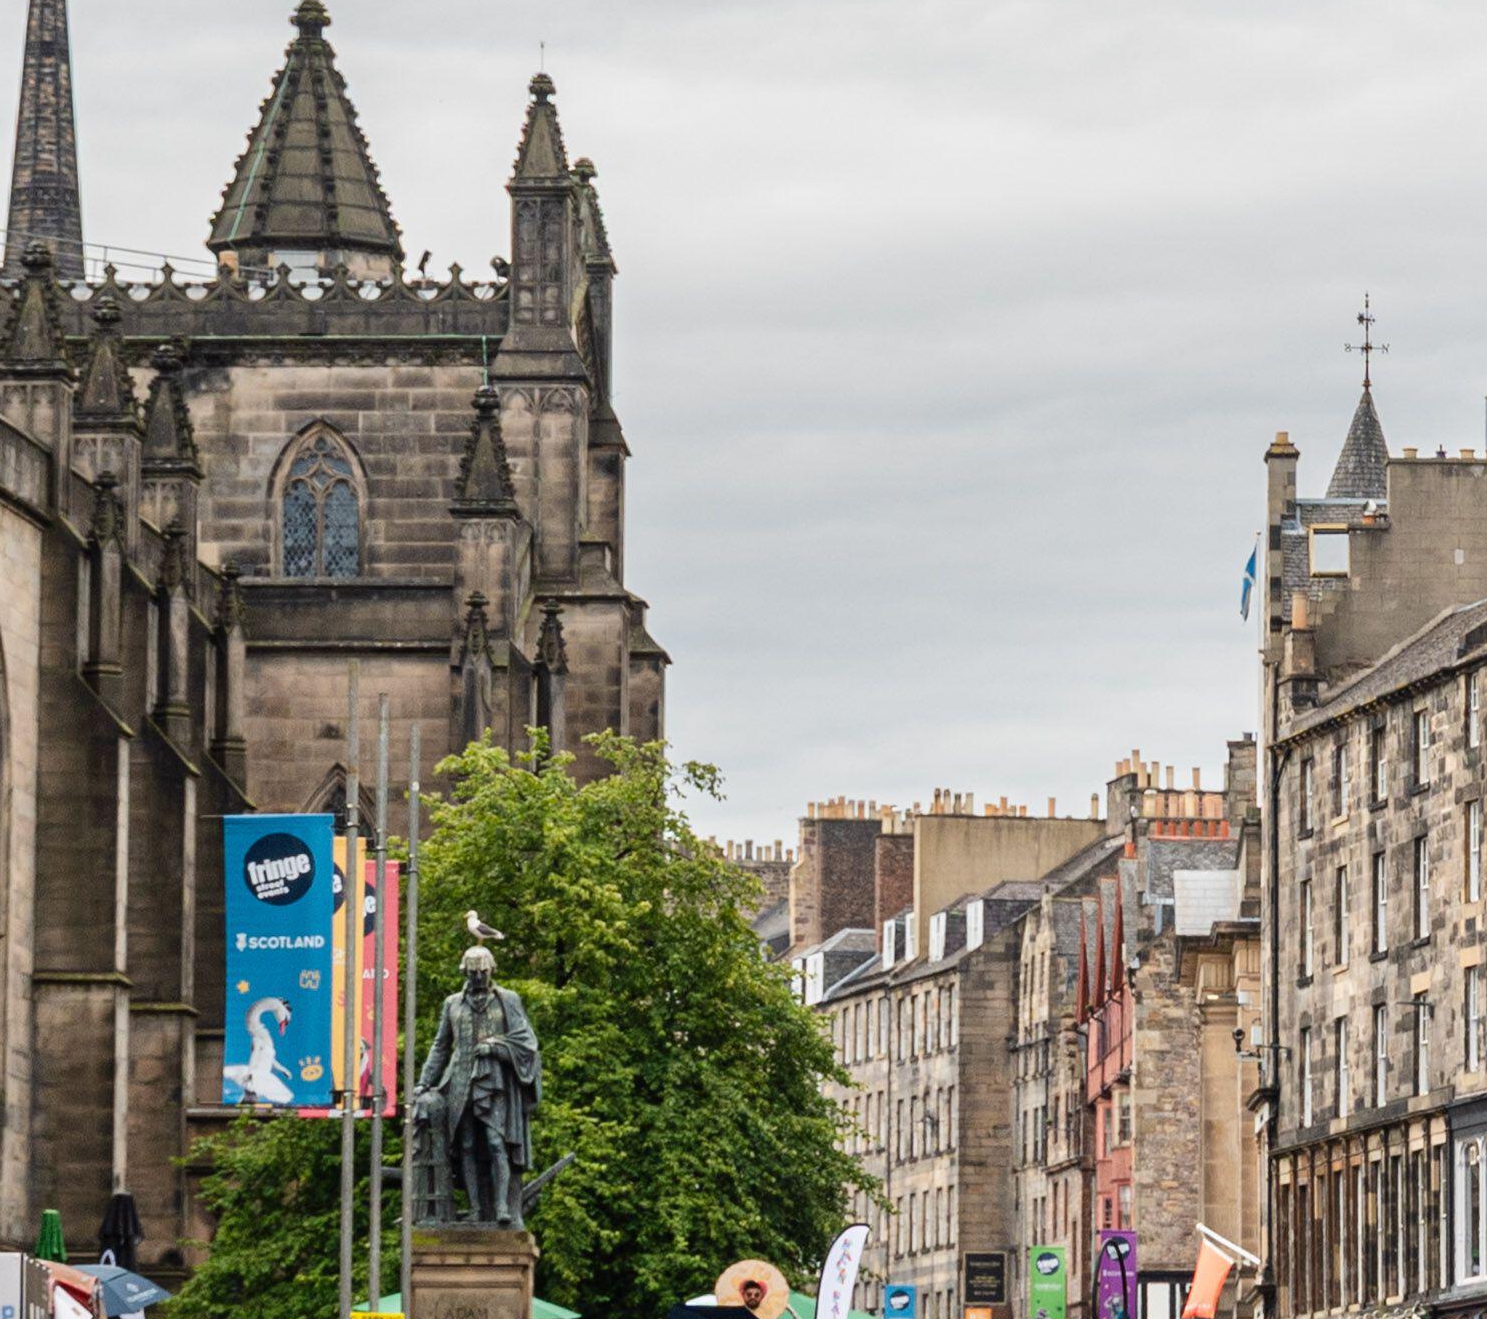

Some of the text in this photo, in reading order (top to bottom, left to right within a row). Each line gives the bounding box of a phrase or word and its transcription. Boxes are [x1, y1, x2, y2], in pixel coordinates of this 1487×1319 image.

[247, 853, 311, 886] fringe
[249, 935, 325, 950] SCOTLAND
[446, 1308, 489, 1319] ADAM
